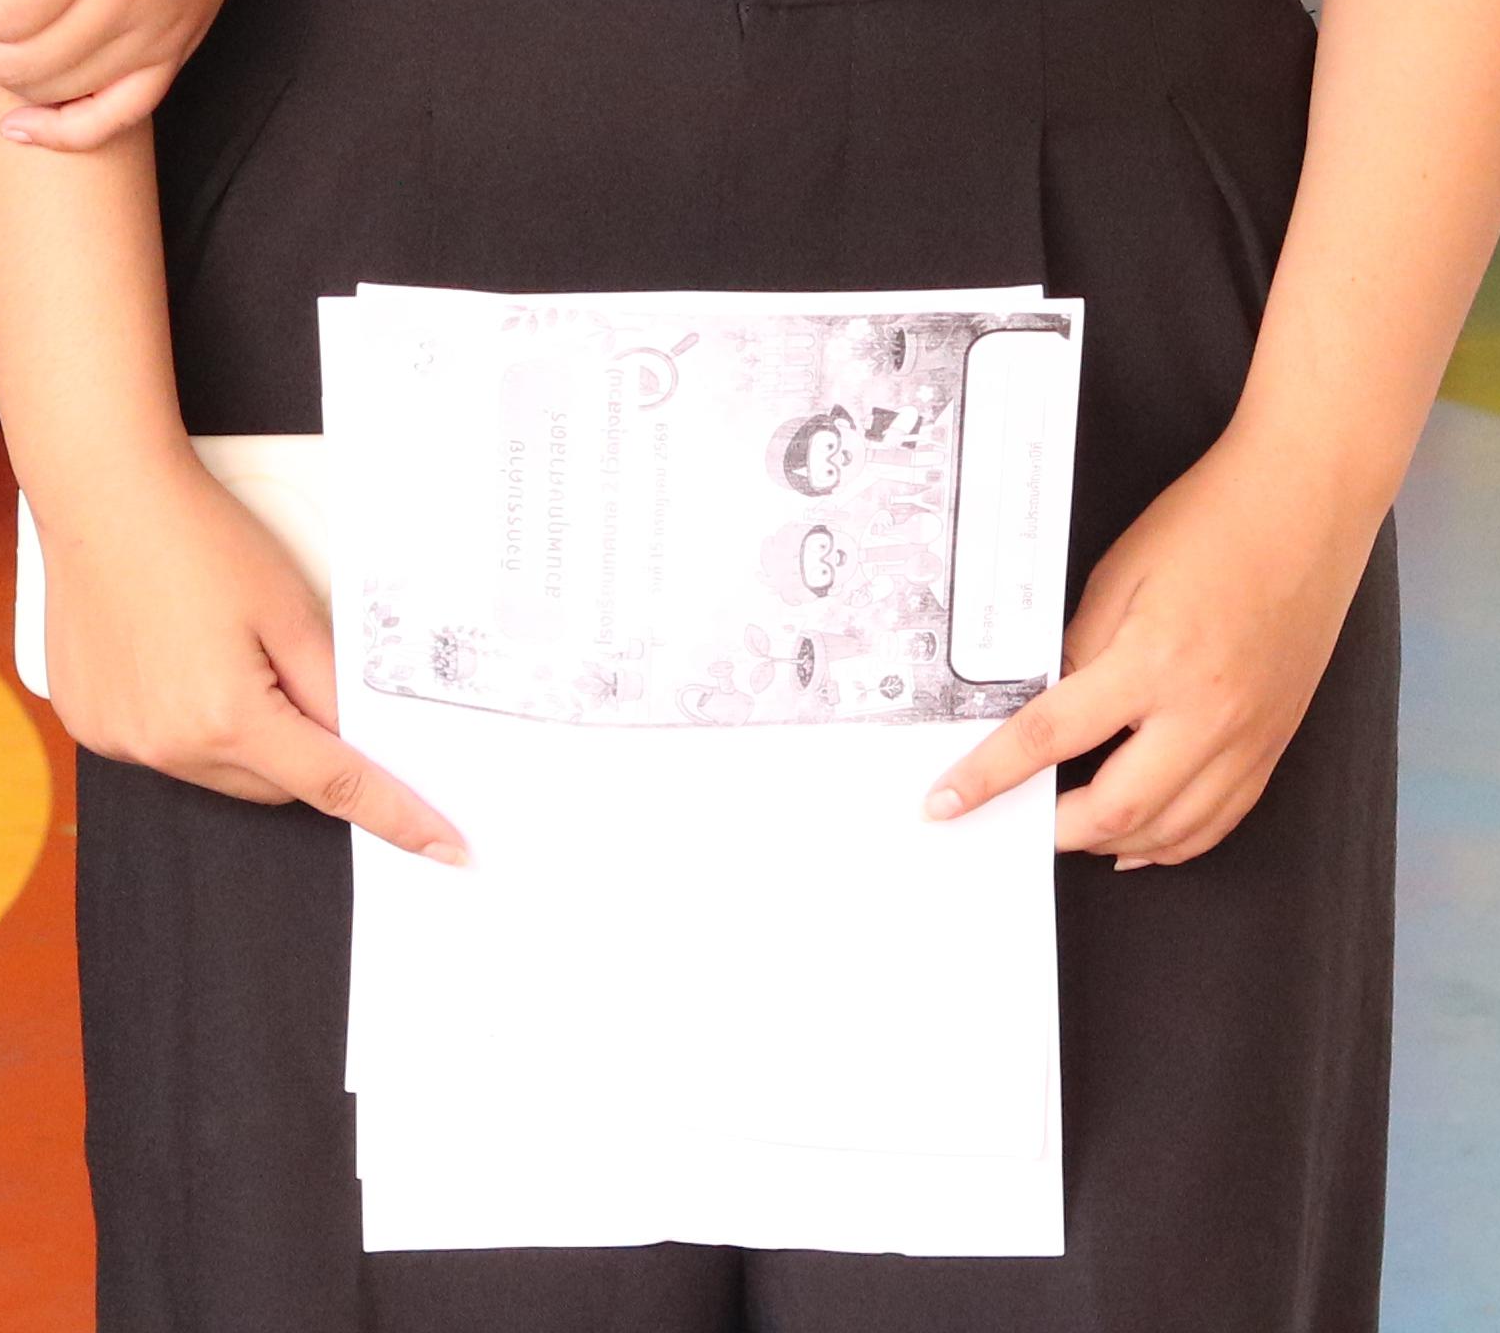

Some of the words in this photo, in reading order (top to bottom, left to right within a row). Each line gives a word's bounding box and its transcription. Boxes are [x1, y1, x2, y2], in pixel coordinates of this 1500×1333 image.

[543, 407, 571, 599] สวนพฤกษศาสตร์
